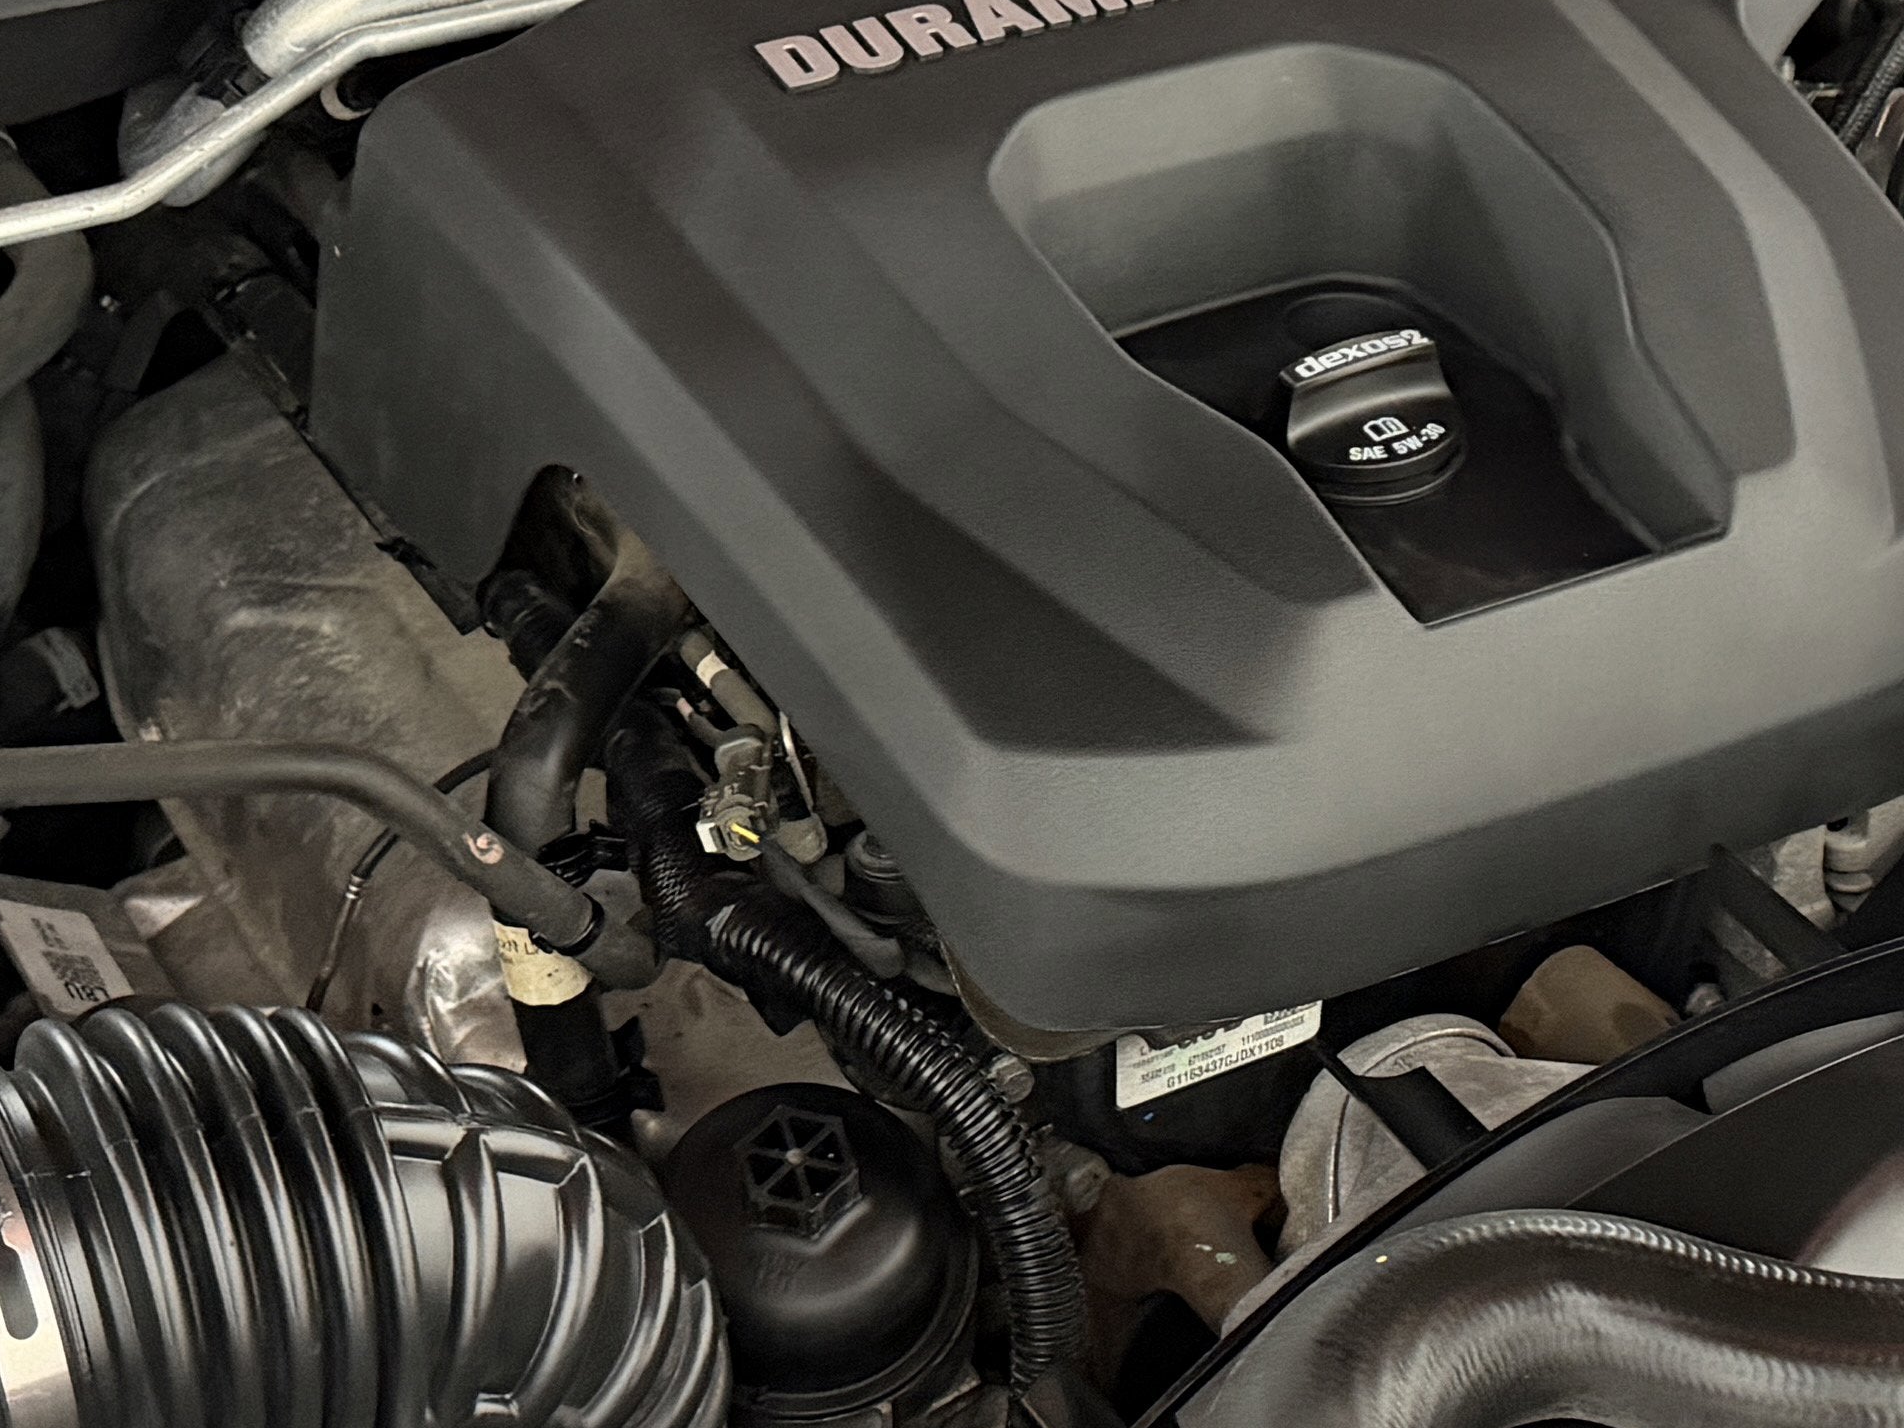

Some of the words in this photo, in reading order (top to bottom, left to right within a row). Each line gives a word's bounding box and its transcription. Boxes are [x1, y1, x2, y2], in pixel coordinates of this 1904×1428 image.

[1295, 328, 1430, 378] dexos2
[1348, 445, 1388, 461] SAE
[1393, 422, 1446, 455] 5W-30
